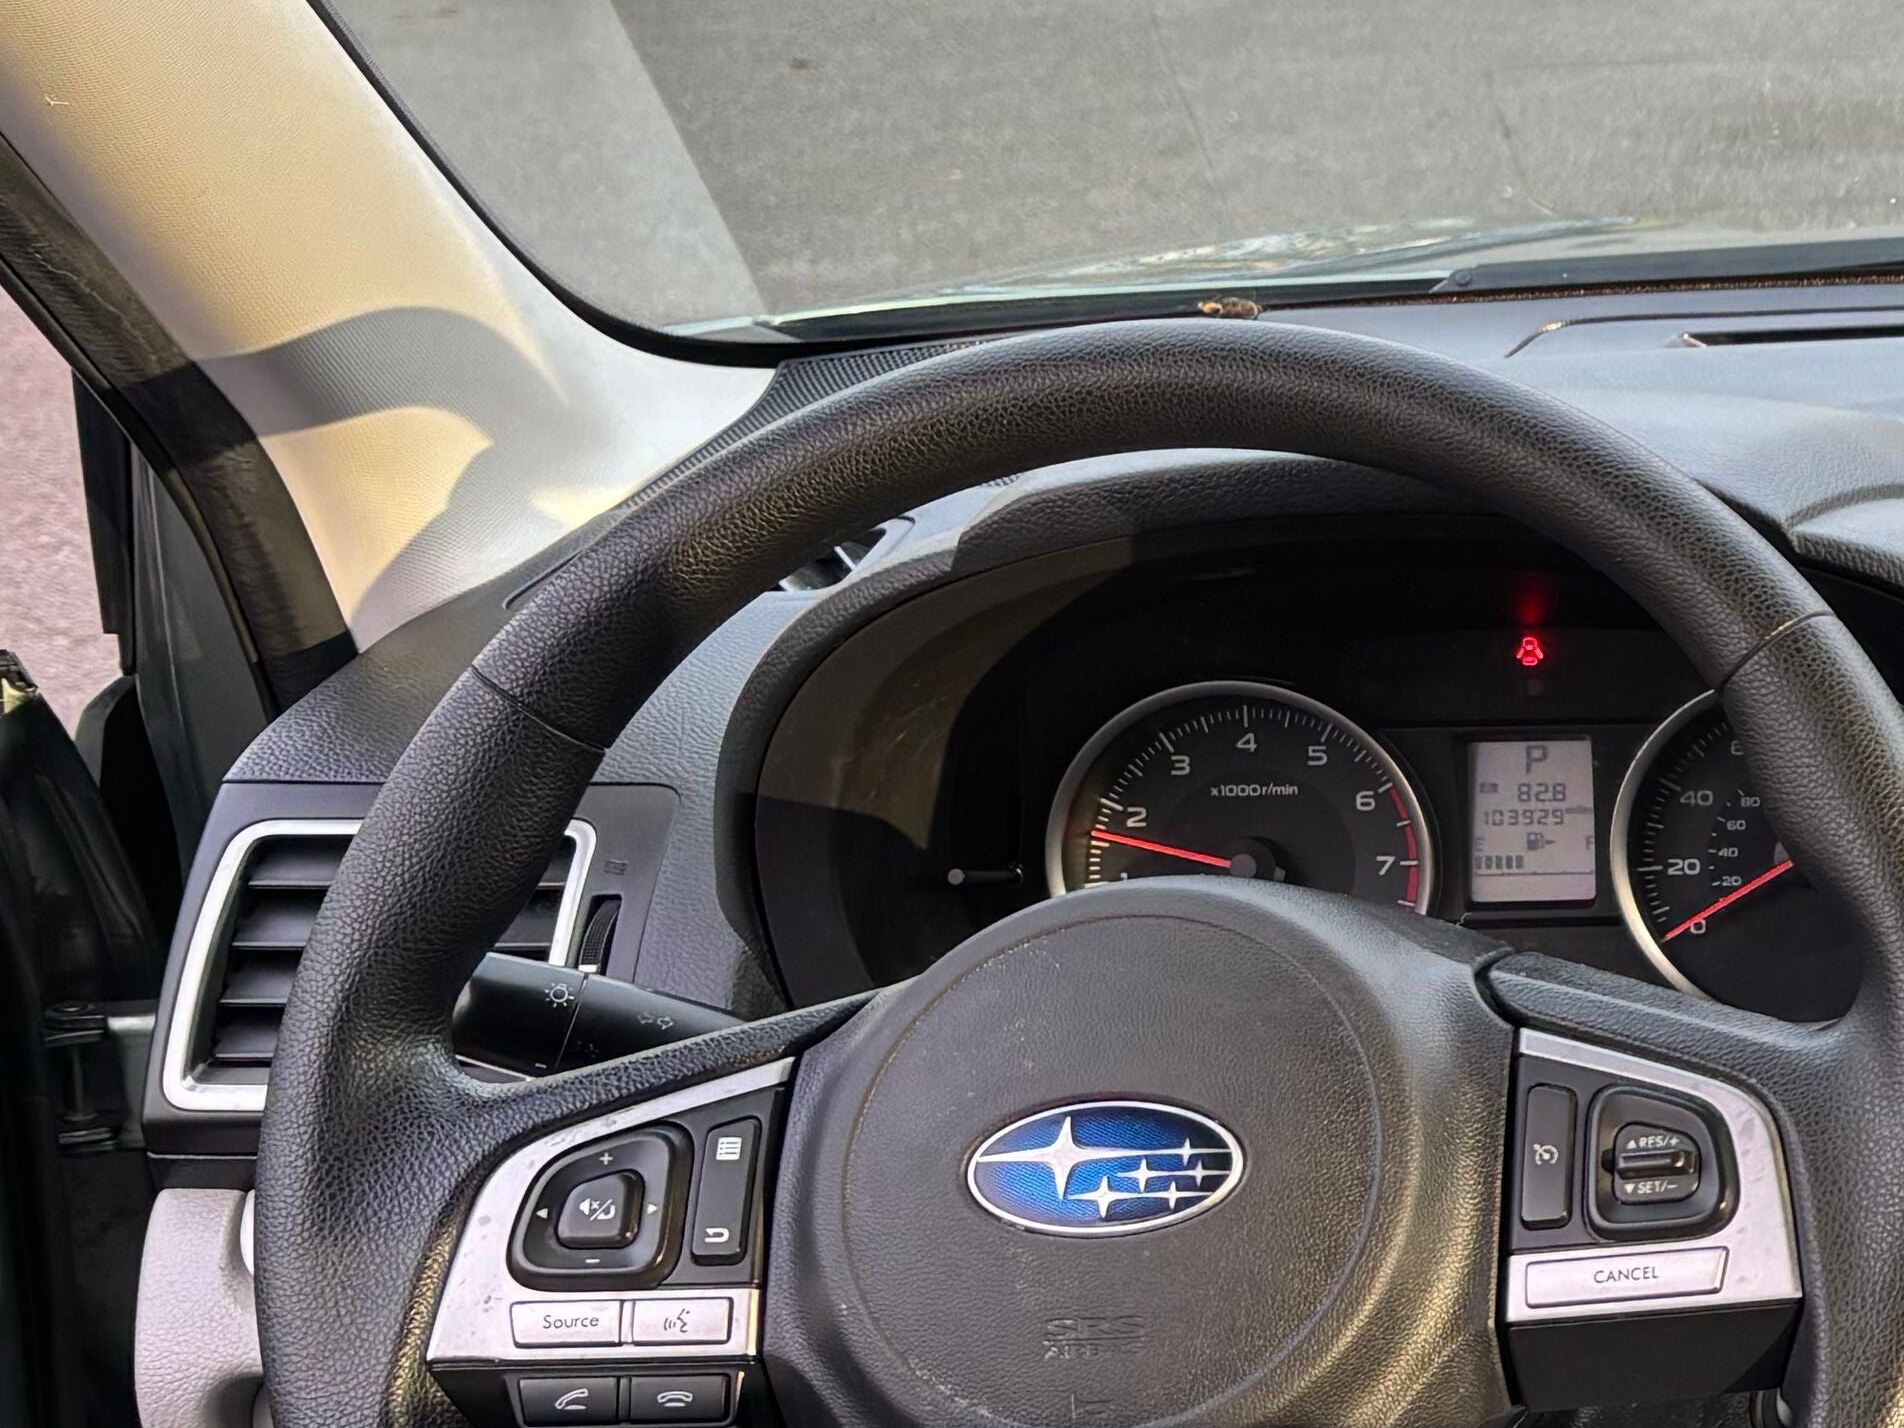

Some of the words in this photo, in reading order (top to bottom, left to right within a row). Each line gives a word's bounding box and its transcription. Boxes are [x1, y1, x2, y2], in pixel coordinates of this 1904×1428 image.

[1236, 733, 1257, 752] 4
[1171, 755, 1191, 776] 3
[1307, 746, 1328, 766] 5
[1525, 744, 1548, 774] P
[1355, 791, 1375, 811] 6
[1680, 789, 1713, 807] 40
[1740, 796, 1760, 808] 80
[1126, 807, 1147, 828] 2
[1726, 820, 1746, 831] 60
[1718, 847, 1738, 858] 40
[1376, 855, 1395, 875] 7
[1667, 858, 1701, 875] 20
[1722, 875, 1742, 887] 20
[1593, 1266, 1660, 1285] CANCEL
[542, 1313, 601, 1330] Source
